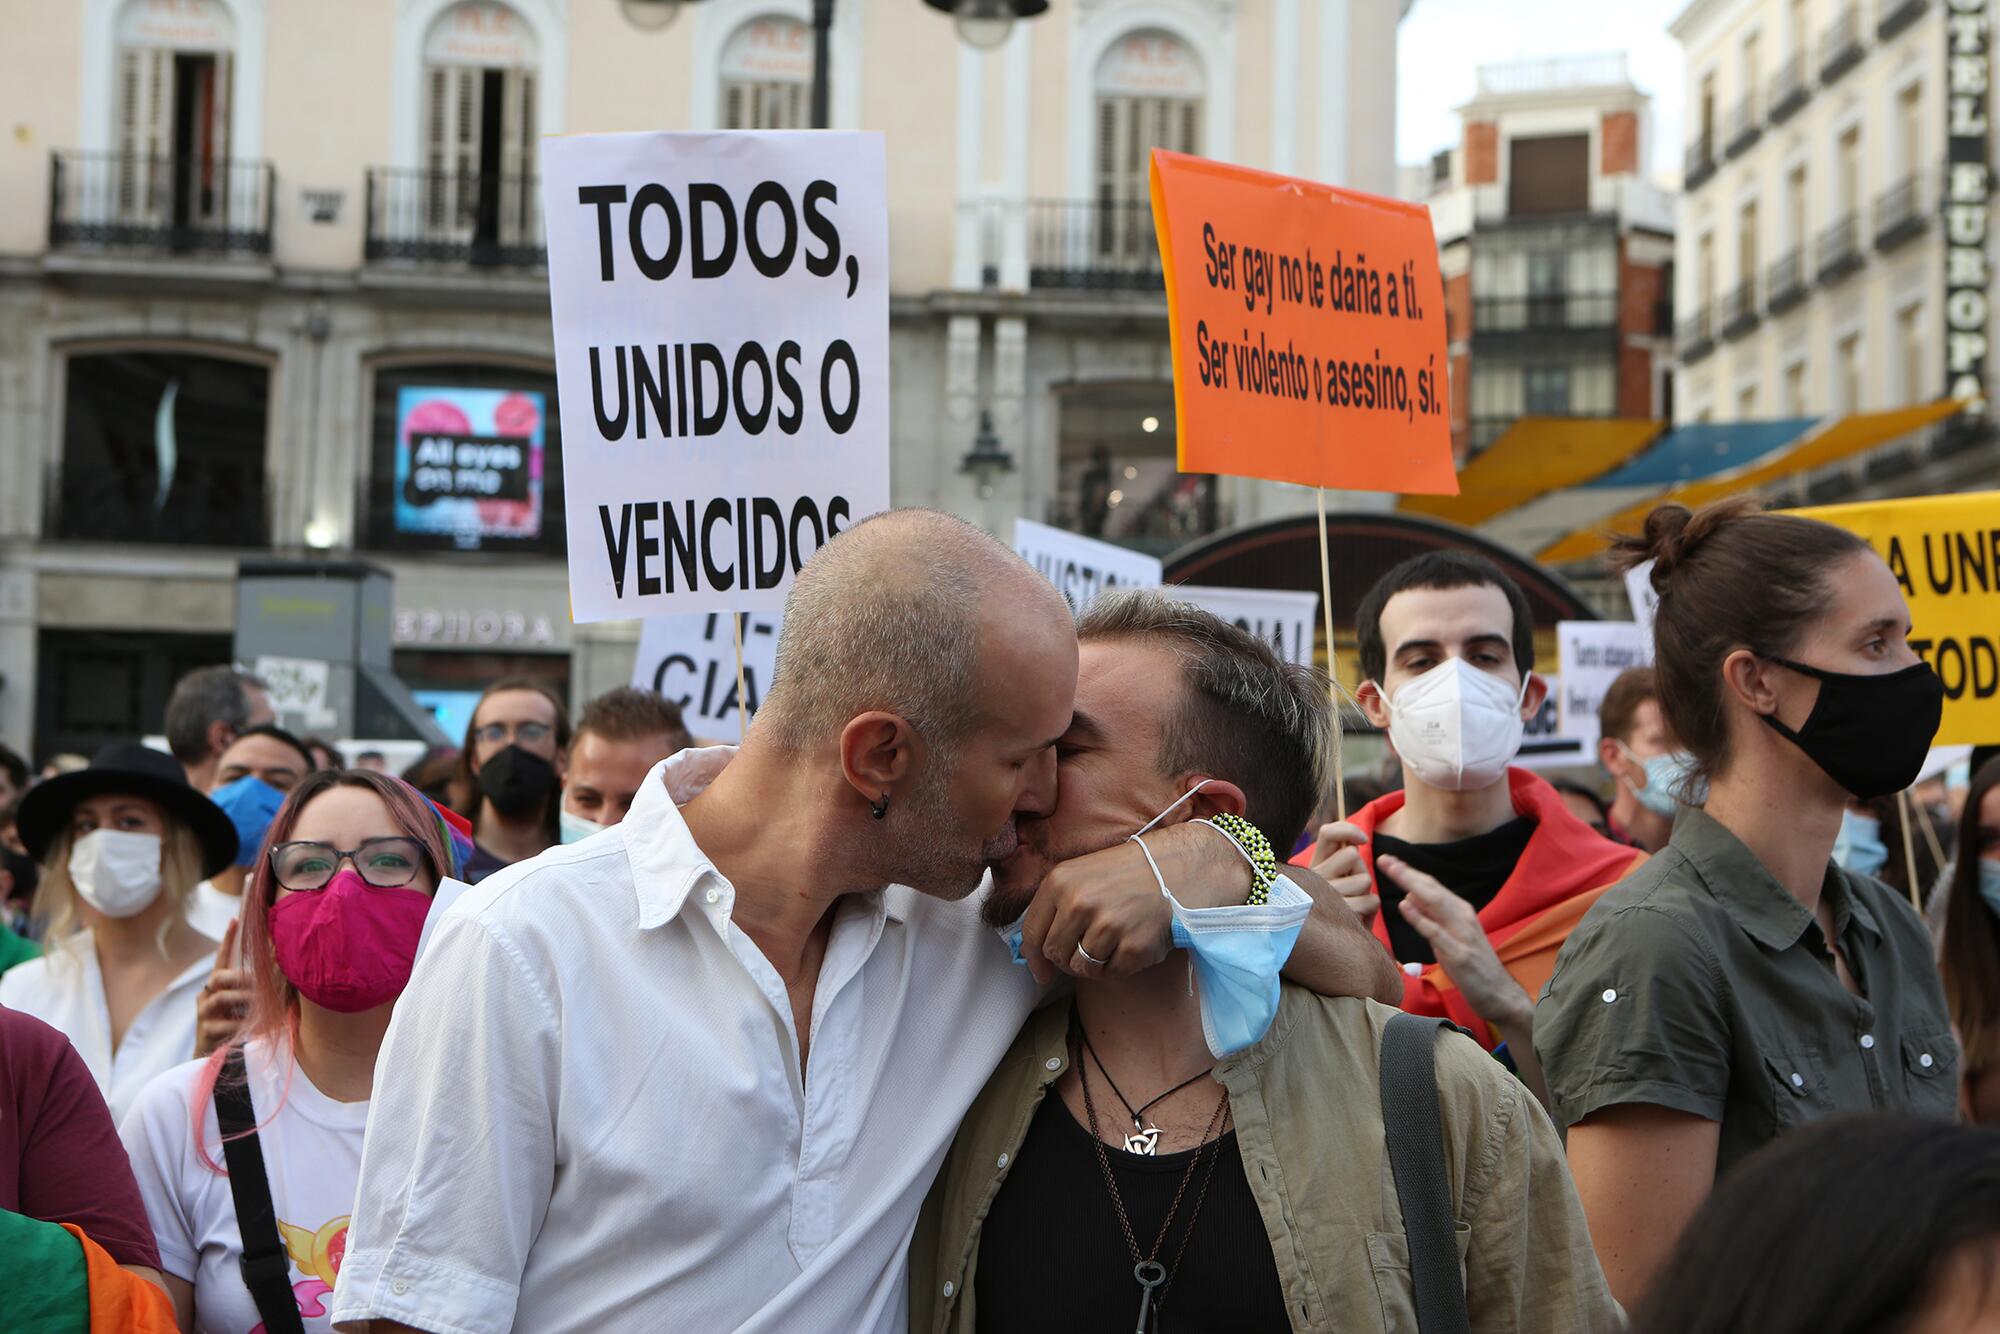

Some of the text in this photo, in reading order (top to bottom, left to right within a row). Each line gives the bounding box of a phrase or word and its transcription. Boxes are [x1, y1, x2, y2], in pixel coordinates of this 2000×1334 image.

[578, 179, 859, 299] TODOS,
[1203, 222, 1423, 320] Ser gay no te daña a tí.
[588, 339, 860, 442] UNIDOS O
[1197, 320, 1441, 424] Ser violento o asesino, sí.
[414, 467, 502, 494] on me
[415, 436, 521, 471] All eyes
[393, 608, 554, 643] EPHORA
[653, 653, 759, 719] CIA
